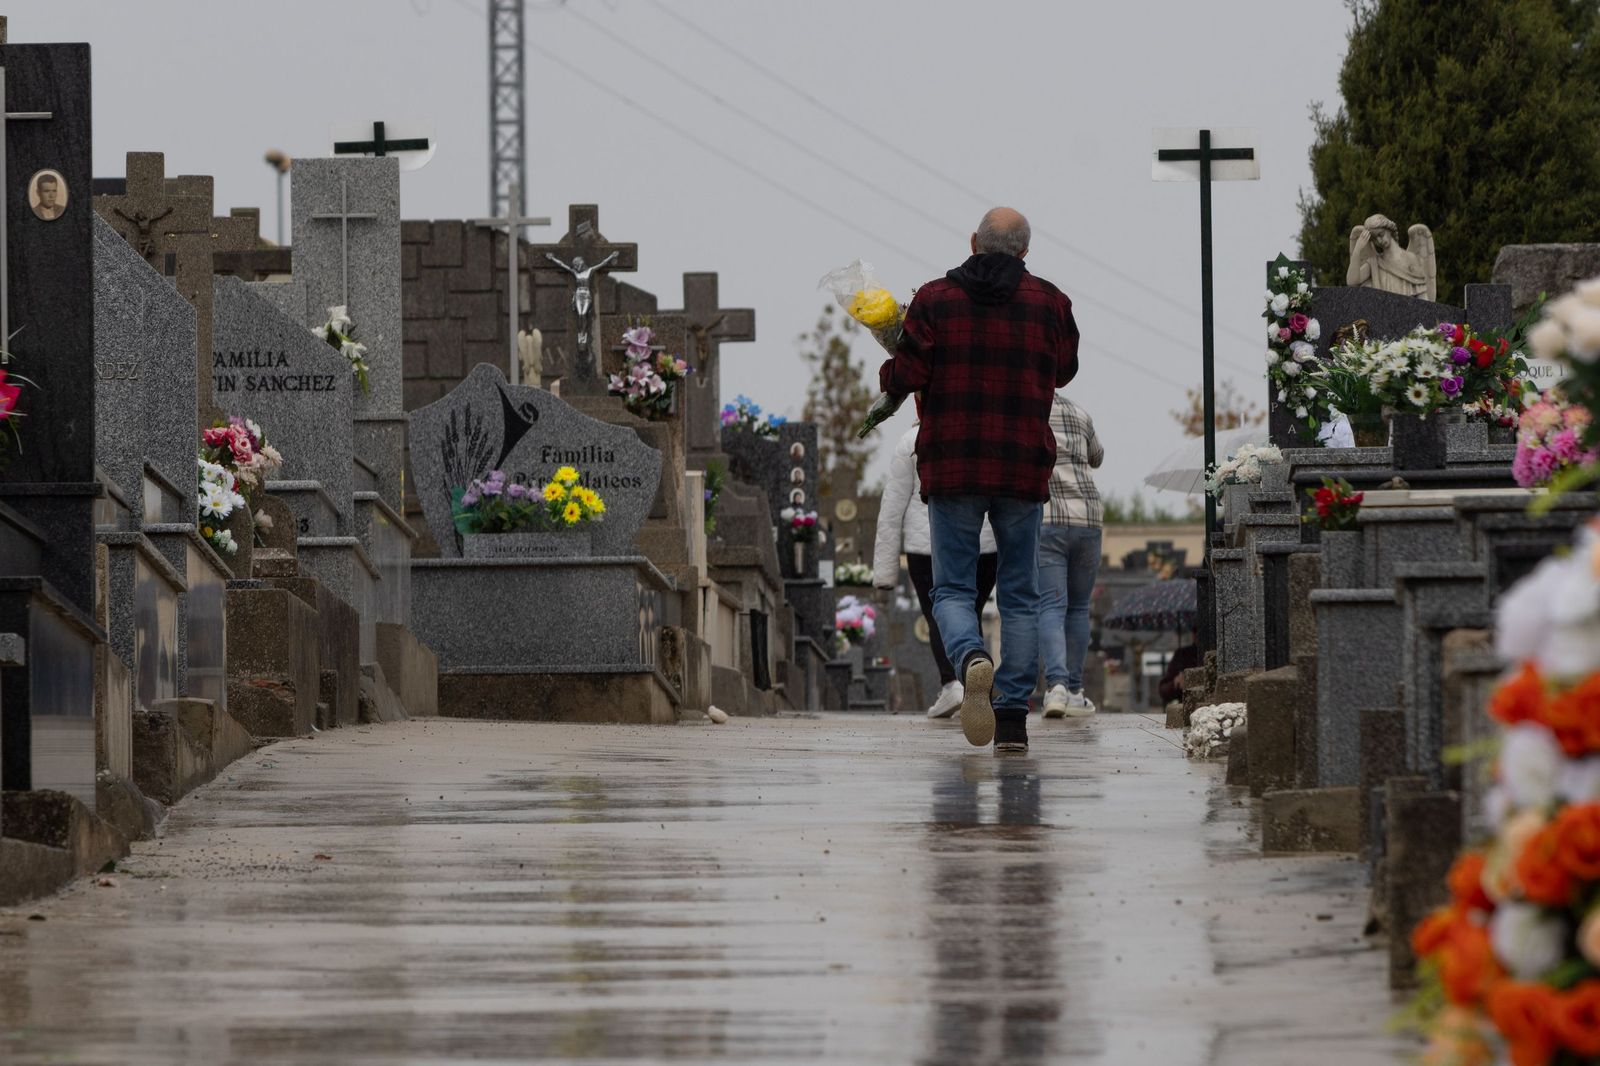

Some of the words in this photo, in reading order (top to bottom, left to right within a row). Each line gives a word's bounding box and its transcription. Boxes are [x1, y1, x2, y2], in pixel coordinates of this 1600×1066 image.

[213, 351, 289, 367] AMILIA
[213, 375, 236, 392] IN
[245, 375, 336, 392] SANCHEZ
[542, 445, 616, 466] Familia
